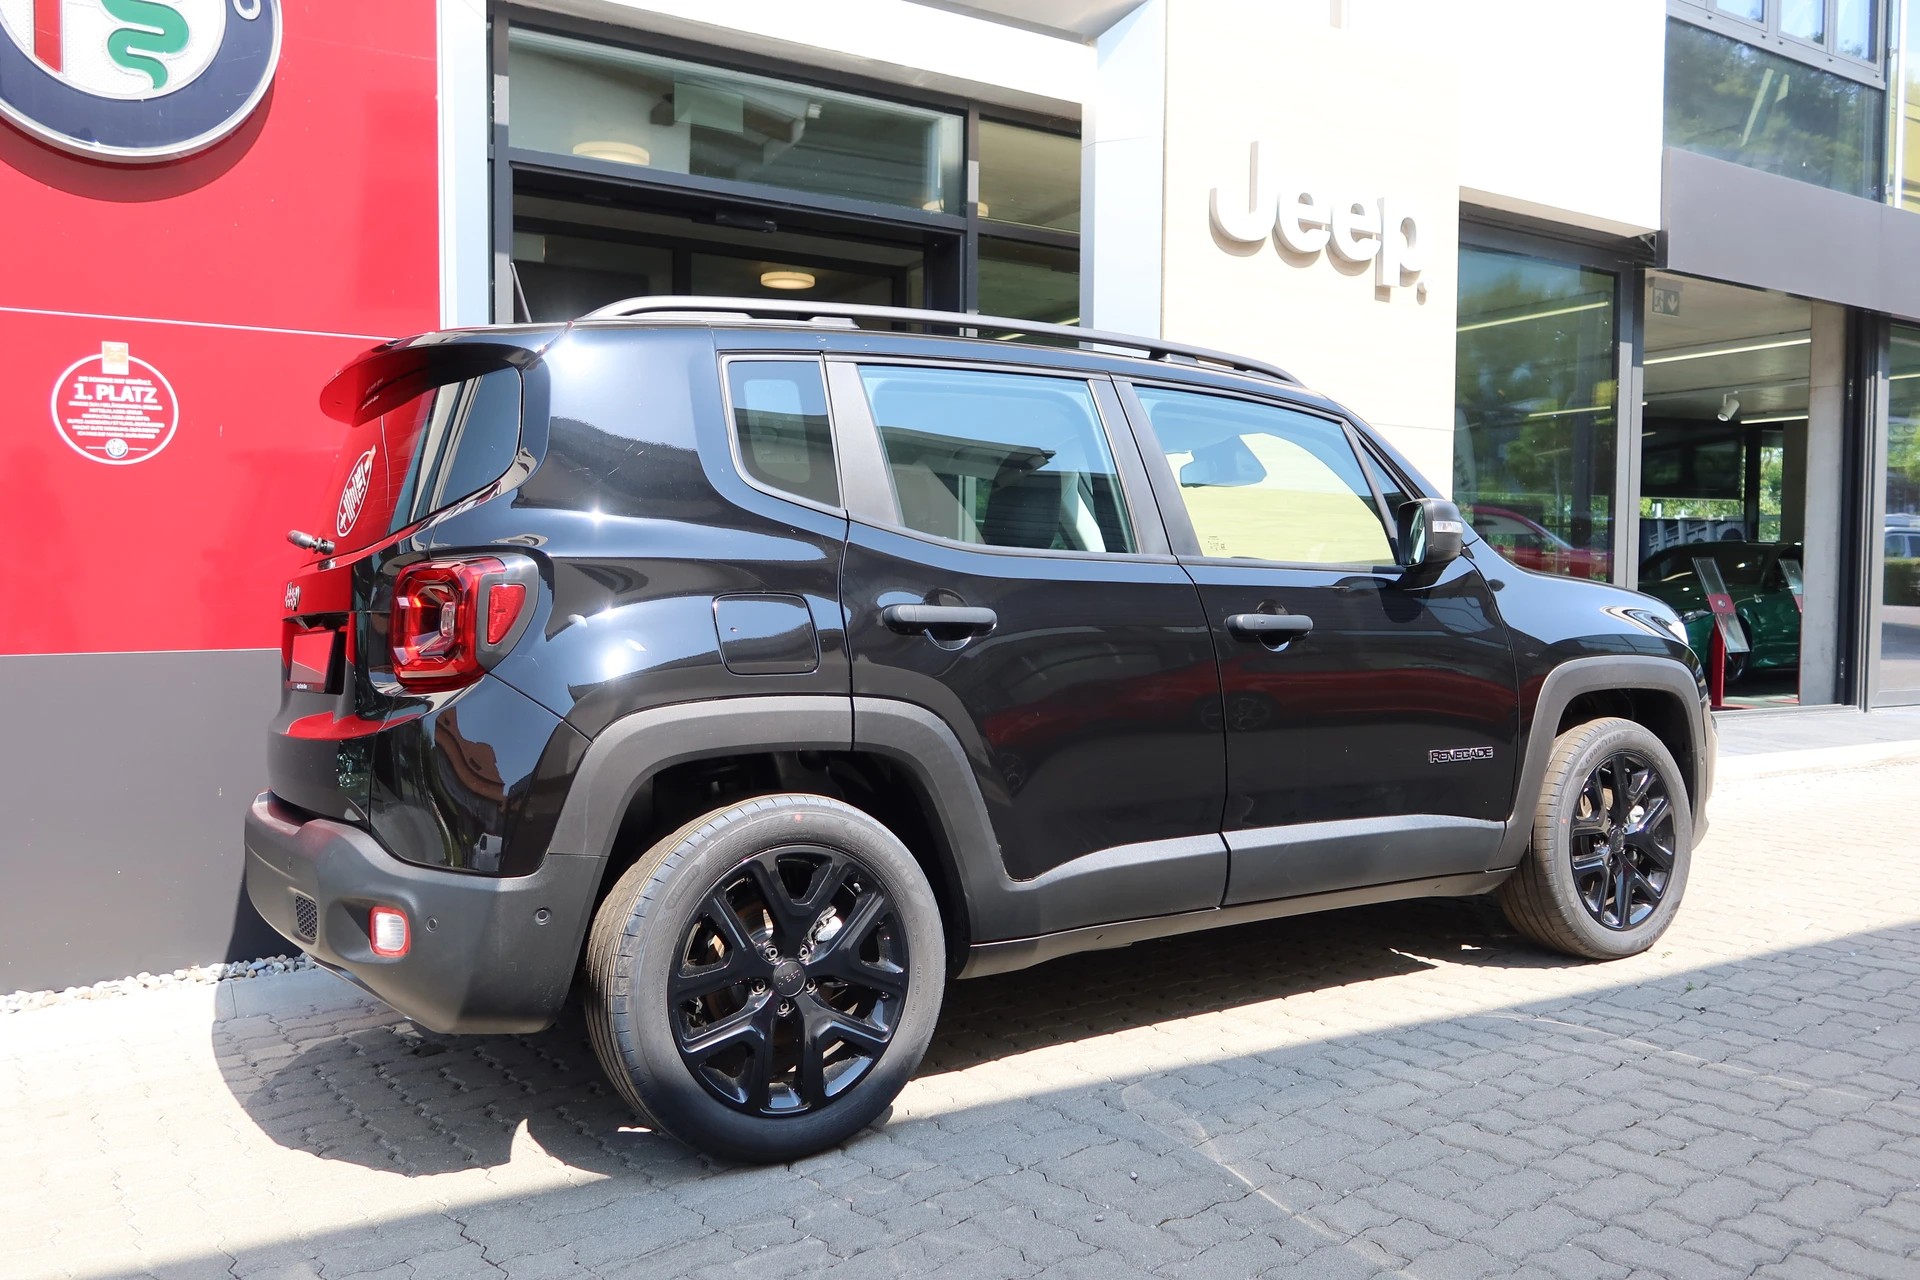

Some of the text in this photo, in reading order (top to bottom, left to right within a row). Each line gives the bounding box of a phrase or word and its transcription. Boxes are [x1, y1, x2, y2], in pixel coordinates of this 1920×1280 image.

[73, 382, 158, 404] 1. PLATZ
[1428, 746, 1494, 764] RENEGADE
